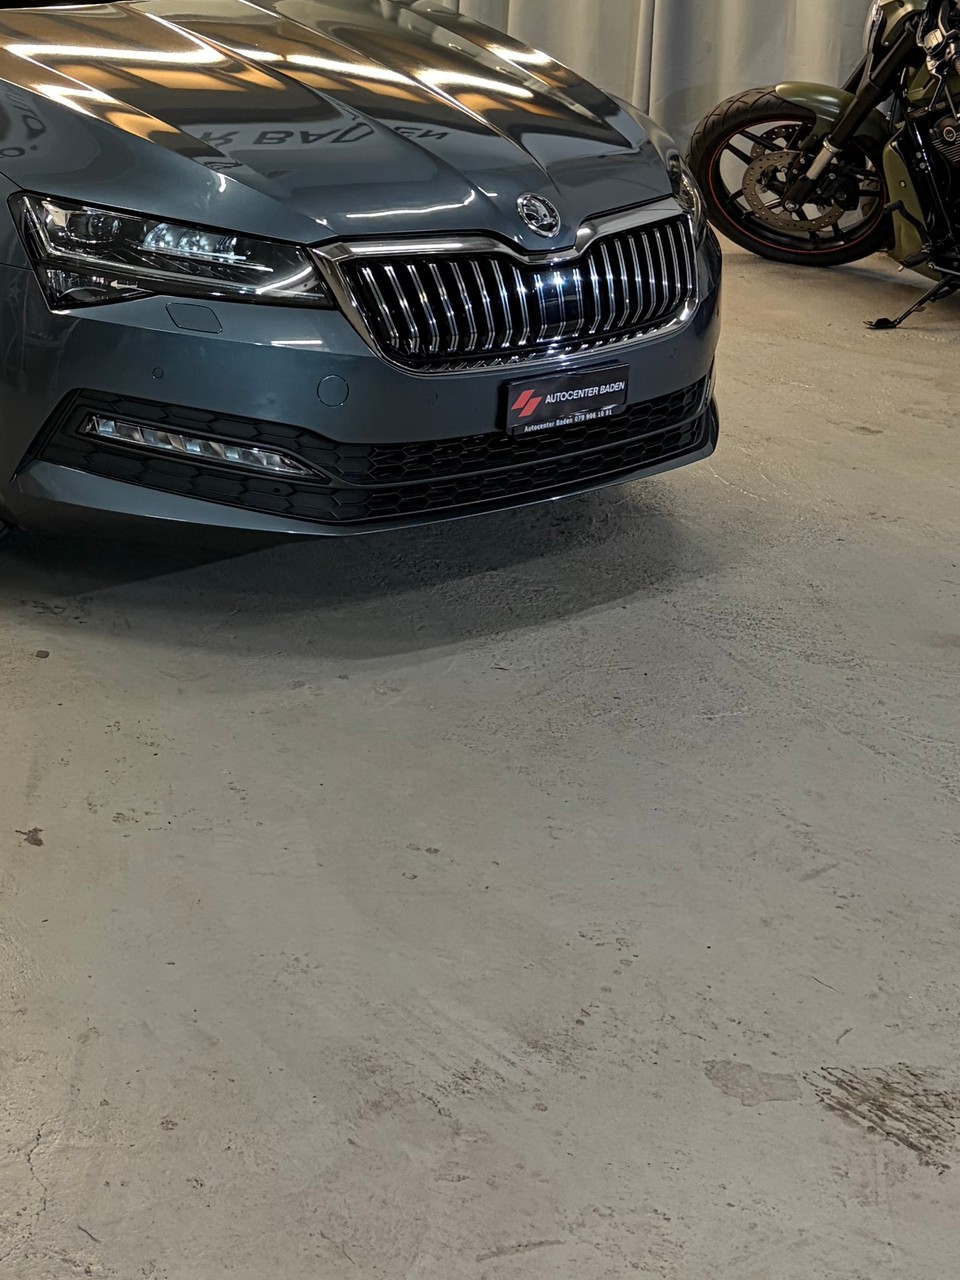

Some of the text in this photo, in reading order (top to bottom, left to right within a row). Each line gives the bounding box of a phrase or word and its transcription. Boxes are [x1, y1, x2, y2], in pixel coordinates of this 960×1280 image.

[545, 381, 625, 404] AUTOCENTER BADEN
[524, 422, 555, 432] Autocenter
[556, 418, 573, 427] Baden
[574, 414, 585, 423] 079
